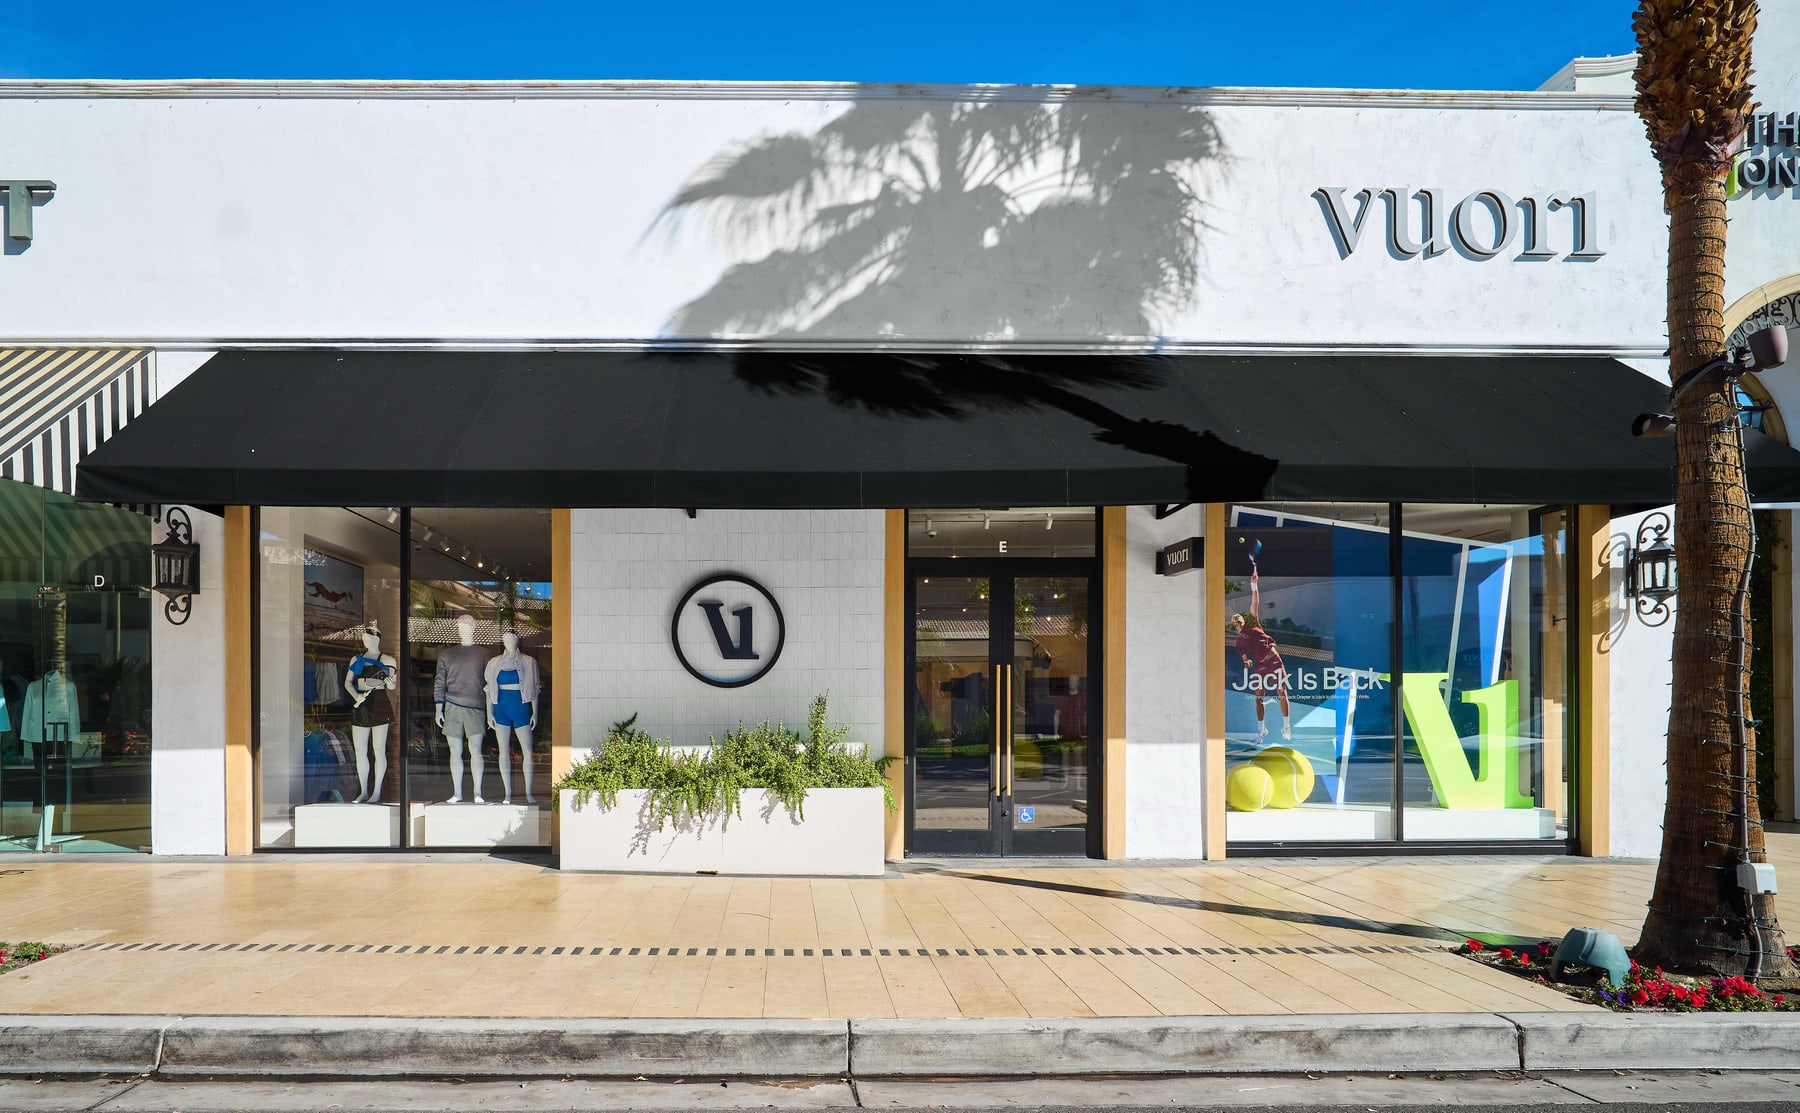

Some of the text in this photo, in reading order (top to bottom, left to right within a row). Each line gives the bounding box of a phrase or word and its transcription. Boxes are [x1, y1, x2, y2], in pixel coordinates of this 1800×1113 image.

[1311, 186, 1607, 261] vuori
[999, 540, 1007, 553] E
[94, 575, 105, 588] D
[1231, 667, 1384, 691] Jack Is Back
